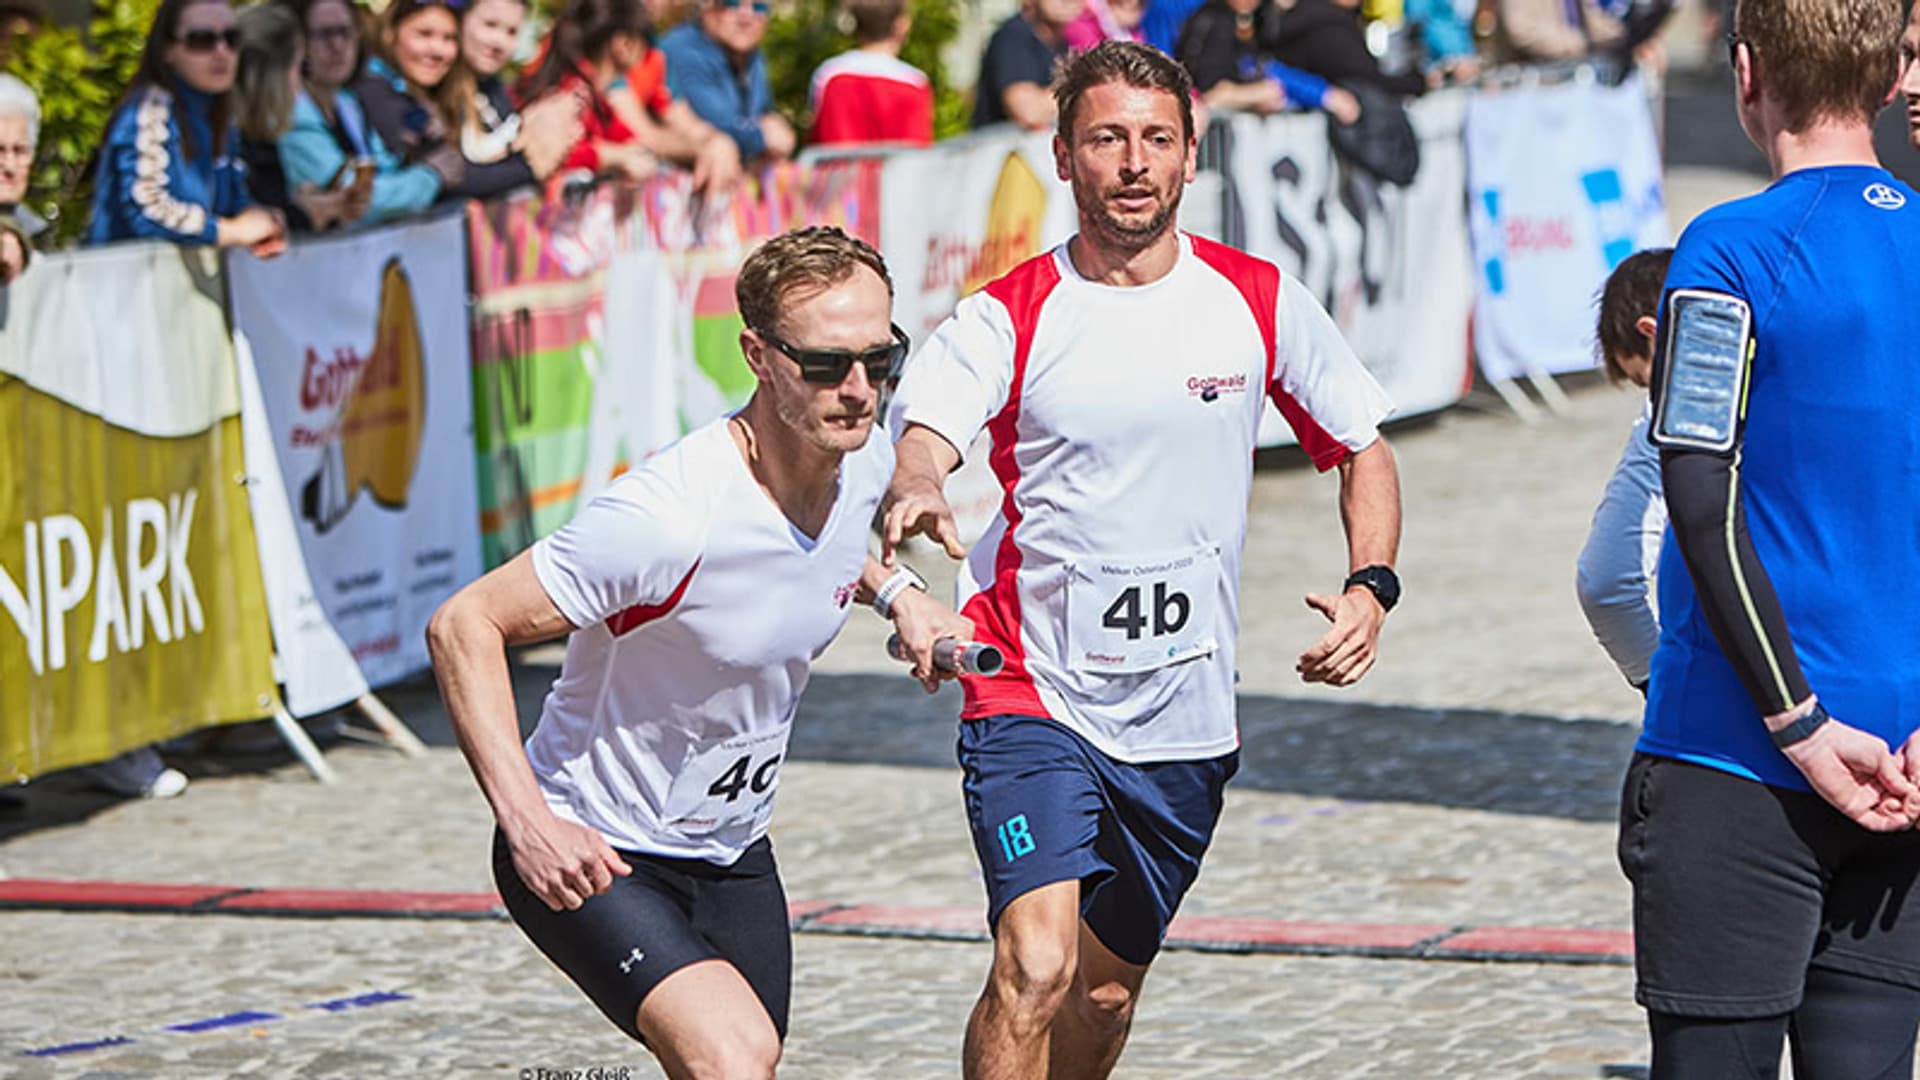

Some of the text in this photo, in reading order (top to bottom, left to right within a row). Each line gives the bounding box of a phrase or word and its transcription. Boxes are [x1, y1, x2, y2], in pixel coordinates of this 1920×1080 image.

[1187, 373, 1247, 391] Gottwald
[1102, 581, 1191, 641] 4b
[998, 813, 1036, 863] 18
